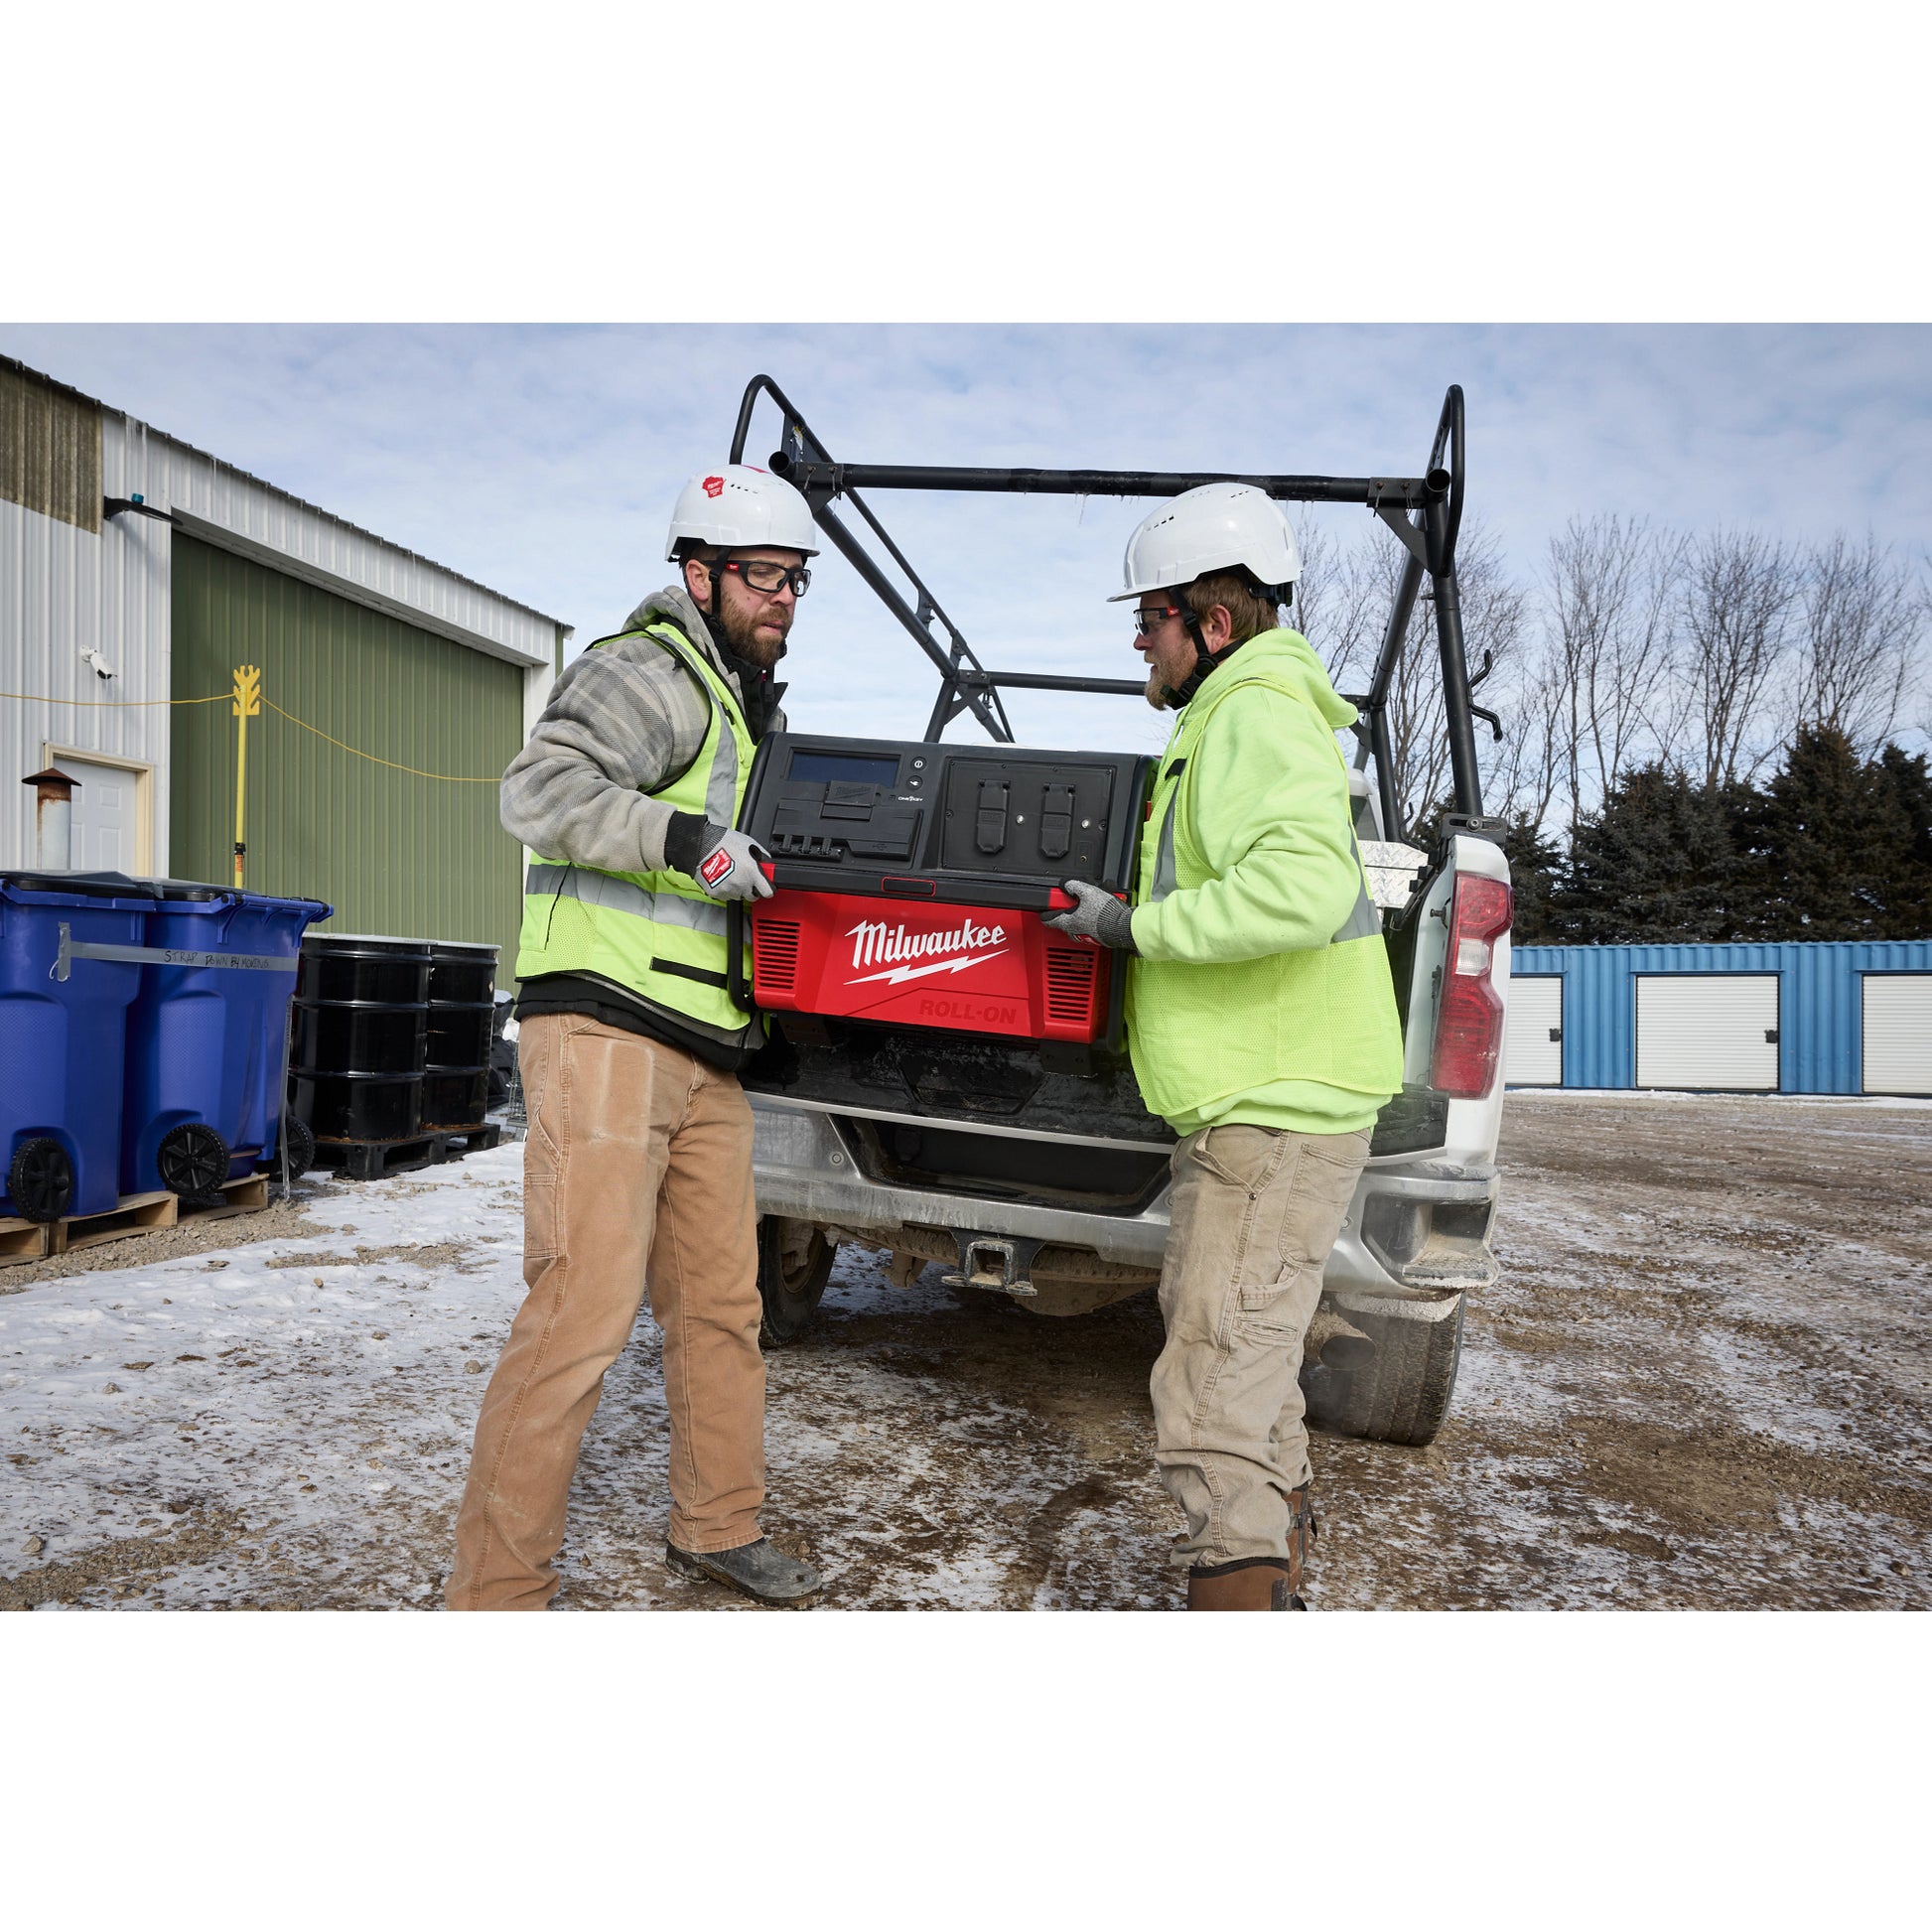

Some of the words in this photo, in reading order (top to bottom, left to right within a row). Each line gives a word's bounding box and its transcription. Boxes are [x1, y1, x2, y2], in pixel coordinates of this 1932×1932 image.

[845, 918, 1007, 970] Milwaukee
[164, 950, 198, 963] STRAP
[206, 955, 227, 967] DOWN
[919, 999, 1017, 1025] ROLL-ON
